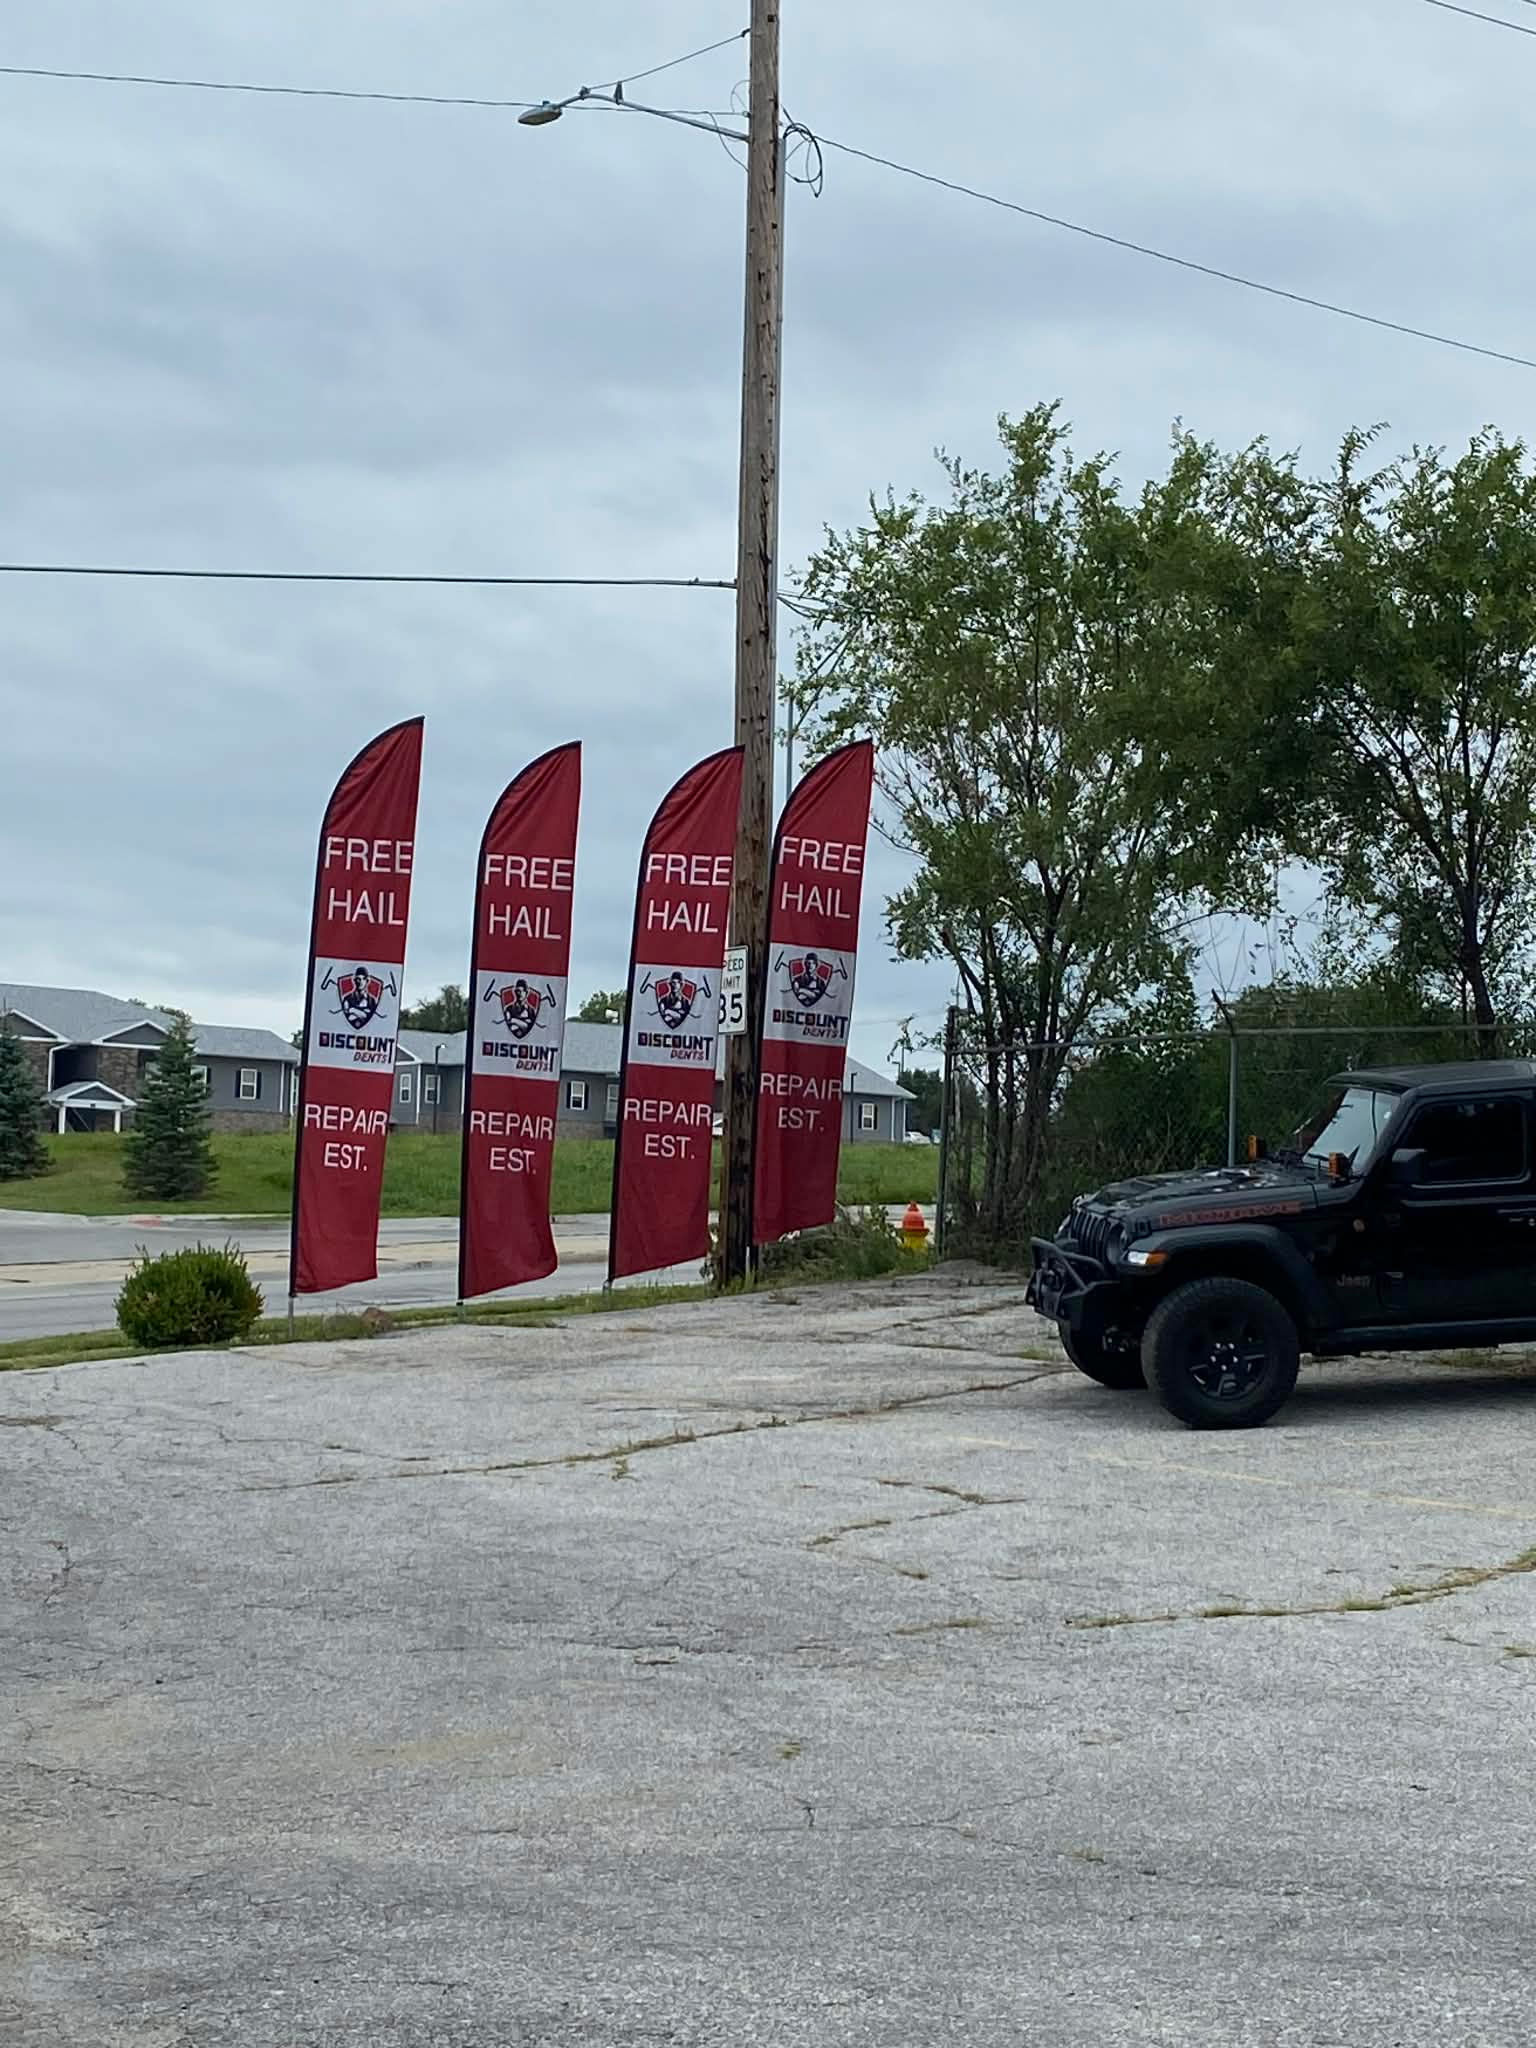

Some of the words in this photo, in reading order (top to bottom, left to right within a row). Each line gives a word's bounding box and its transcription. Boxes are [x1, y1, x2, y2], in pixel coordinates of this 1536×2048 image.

[325, 837, 413, 874] FREE
[779, 837, 863, 874] FREE
[484, 854, 573, 891] FREE
[646, 854, 732, 886] FREE
[328, 888, 404, 926] HAIL
[781, 883, 850, 919] HAIL
[488, 904, 561, 939] HAIL
[647, 901, 718, 932] HAIL
[722, 958, 744, 972] PEED
[723, 976, 740, 989] IMIT
[773, 1009, 848, 1038] DISCOUNT
[802, 1027, 837, 1038] DENTS
[319, 1032, 395, 1064] DISCOUNT
[353, 1052, 387, 1062] DENTS
[482, 1041, 558, 1072] DISCOUNT
[638, 1032, 712, 1060] DISCOUNT
[670, 1049, 704, 1060] DENTS
[516, 1060, 548, 1071] DENTS
[760, 1073, 842, 1101] REPAIR
[304, 1104, 388, 1134] REPAIR
[470, 1111, 553, 1140] REPAIR
[624, 1098, 712, 1126] REPAIR
[778, 1107, 824, 1132] EST.
[324, 1143, 368, 1171] EST.
[645, 1134, 695, 1159] EST.
[490, 1148, 536, 1174] EST.
